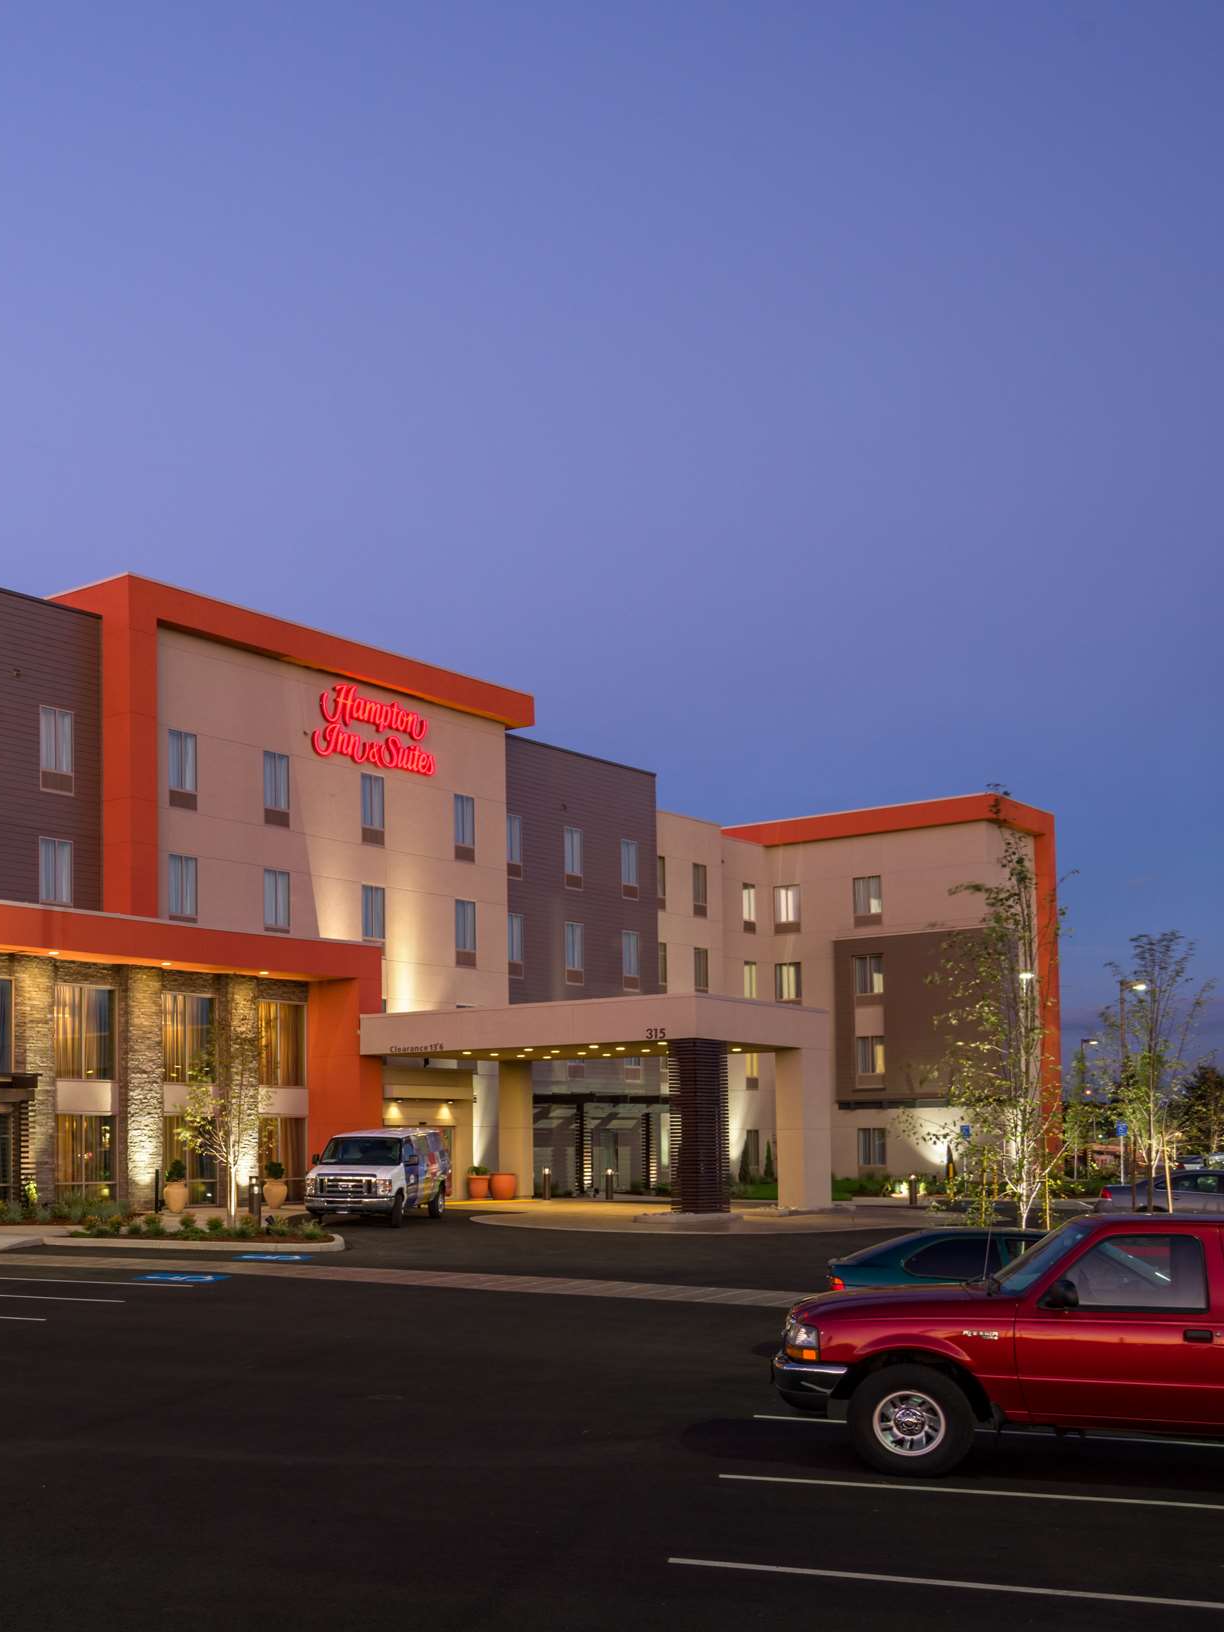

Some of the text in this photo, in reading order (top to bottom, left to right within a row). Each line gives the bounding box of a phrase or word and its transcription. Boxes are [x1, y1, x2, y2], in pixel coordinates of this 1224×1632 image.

[319, 683, 427, 741] Hampton
[312, 724, 436, 777] Inn & Suites
[645, 1027, 667, 1040] 315
